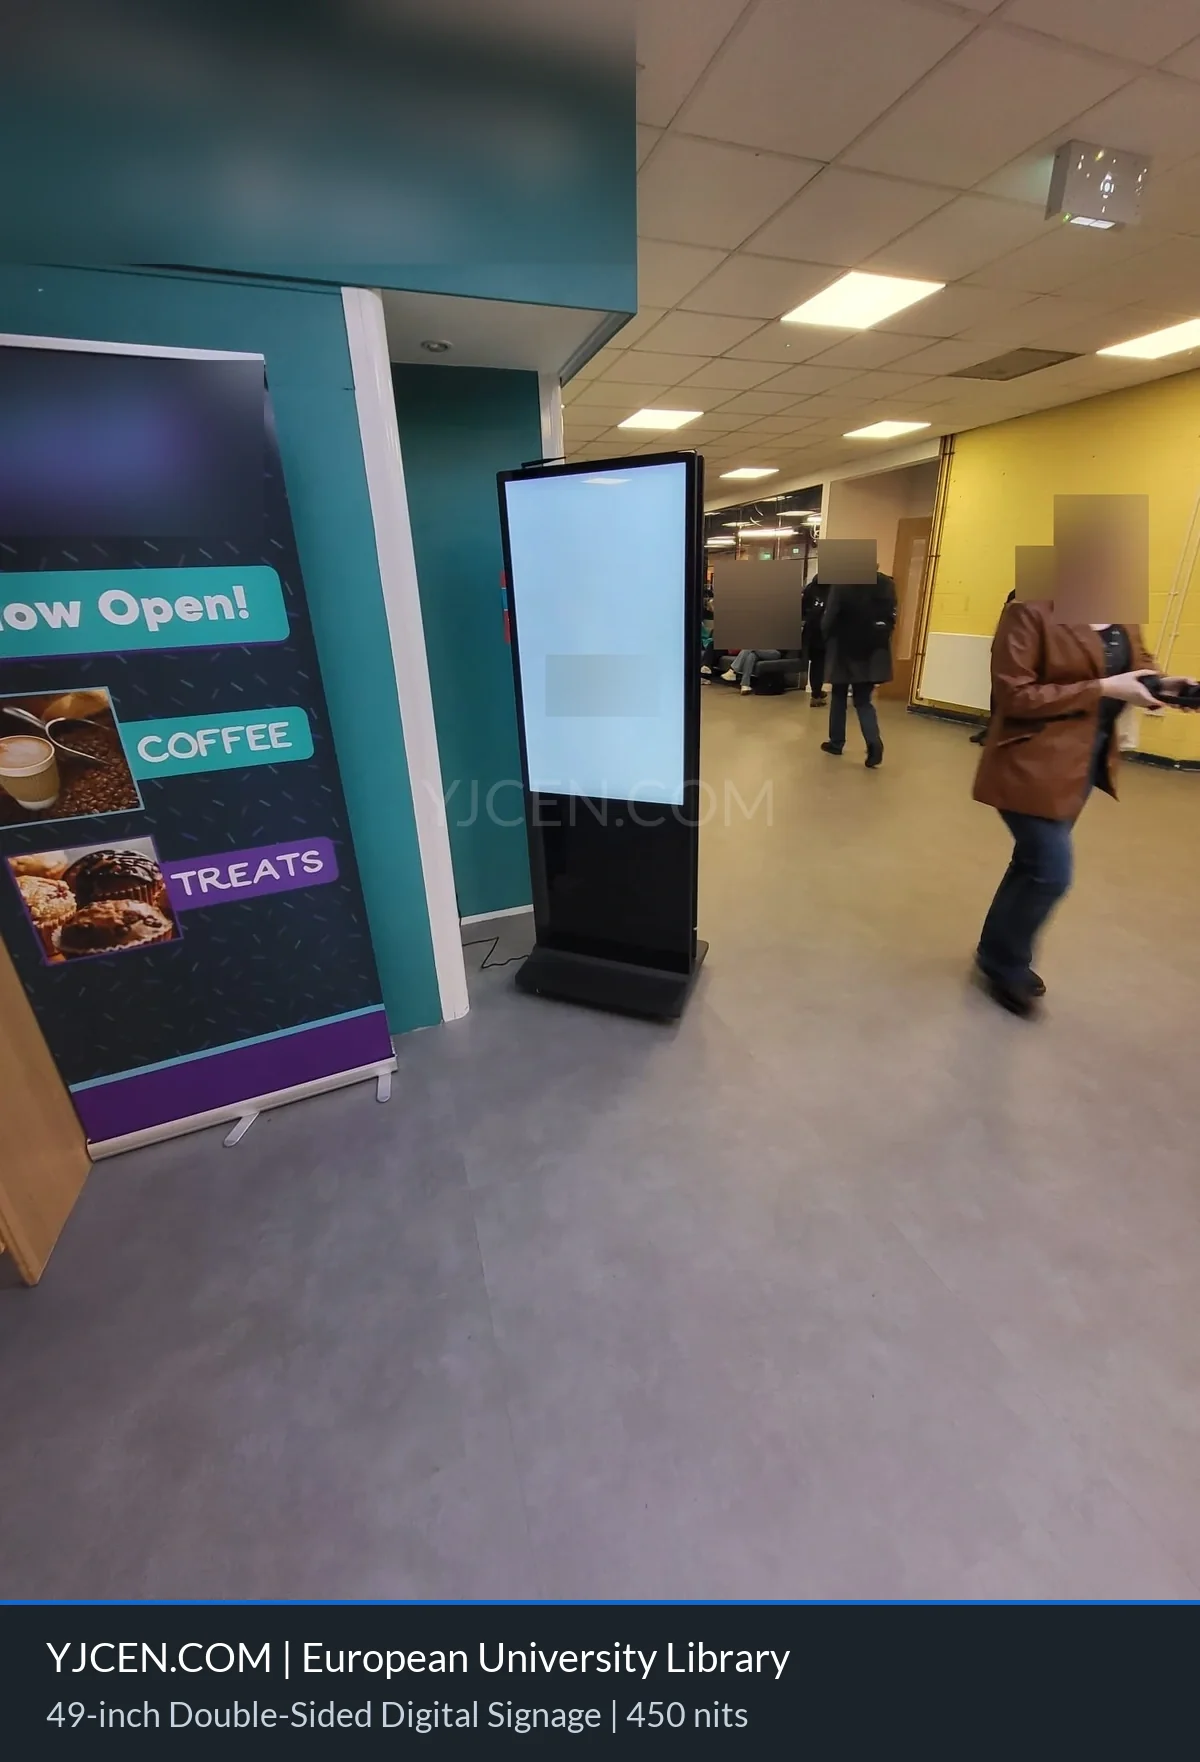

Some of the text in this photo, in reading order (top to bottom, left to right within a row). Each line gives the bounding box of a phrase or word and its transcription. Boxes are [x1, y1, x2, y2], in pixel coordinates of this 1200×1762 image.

[0, 585, 249, 632] ow Open!
[137, 721, 293, 763] COFFEE
[170, 850, 324, 896] TREATS
